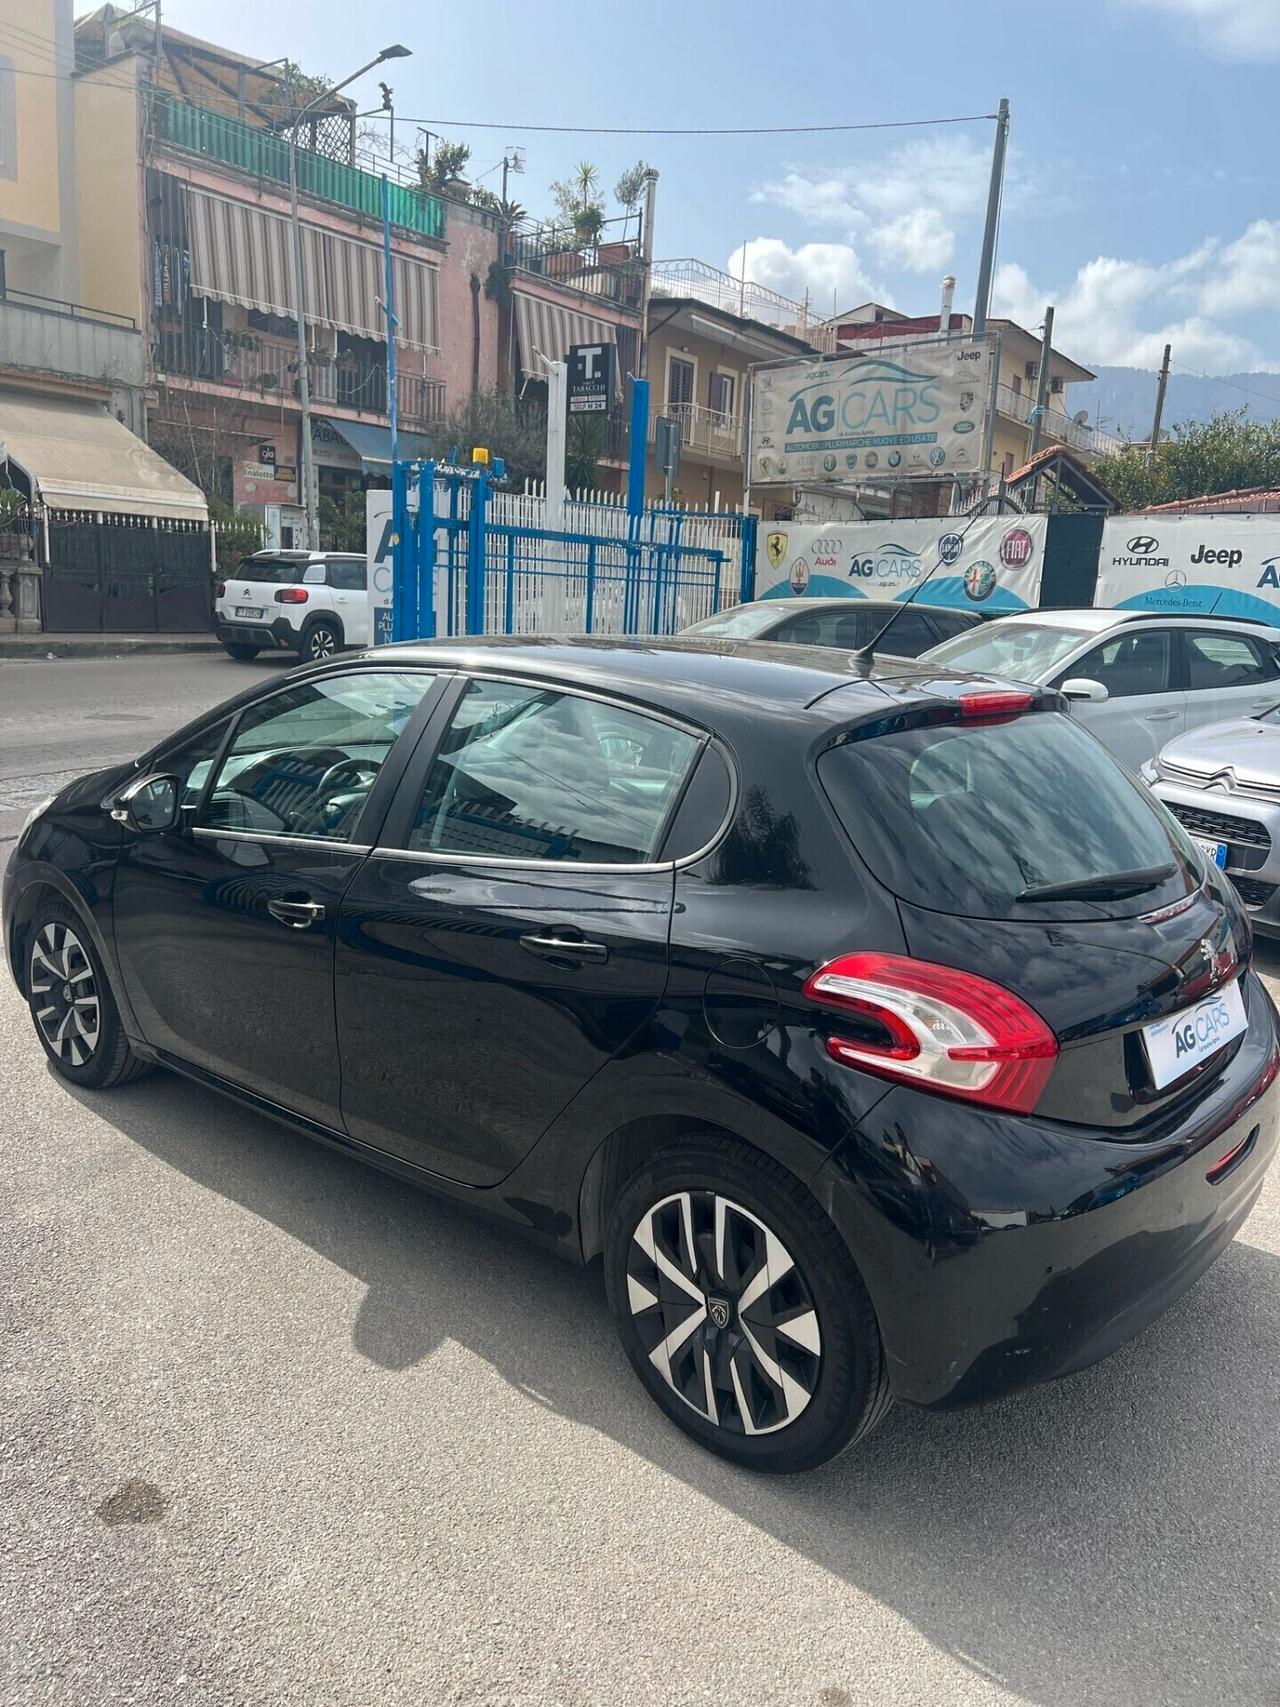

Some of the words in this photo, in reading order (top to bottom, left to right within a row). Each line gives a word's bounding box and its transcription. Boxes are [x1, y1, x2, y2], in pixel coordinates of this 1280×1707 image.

[957, 351, 981, 361] Jeep
[784, 395, 835, 435] AG
[841, 384, 944, 430] CARS
[1006, 540, 1028, 559] FIAT
[1190, 545, 1243, 568] Jeep
[815, 557, 836, 566] Audi
[848, 559, 874, 577] AG
[876, 559, 922, 578] CARS
[1112, 557, 1169, 567] HYUNDAI
[1145, 596, 1202, 607] Mercedes-Benz
[1175, 1024, 1197, 1058] AG
[1196, 1003, 1230, 1041] CARS
